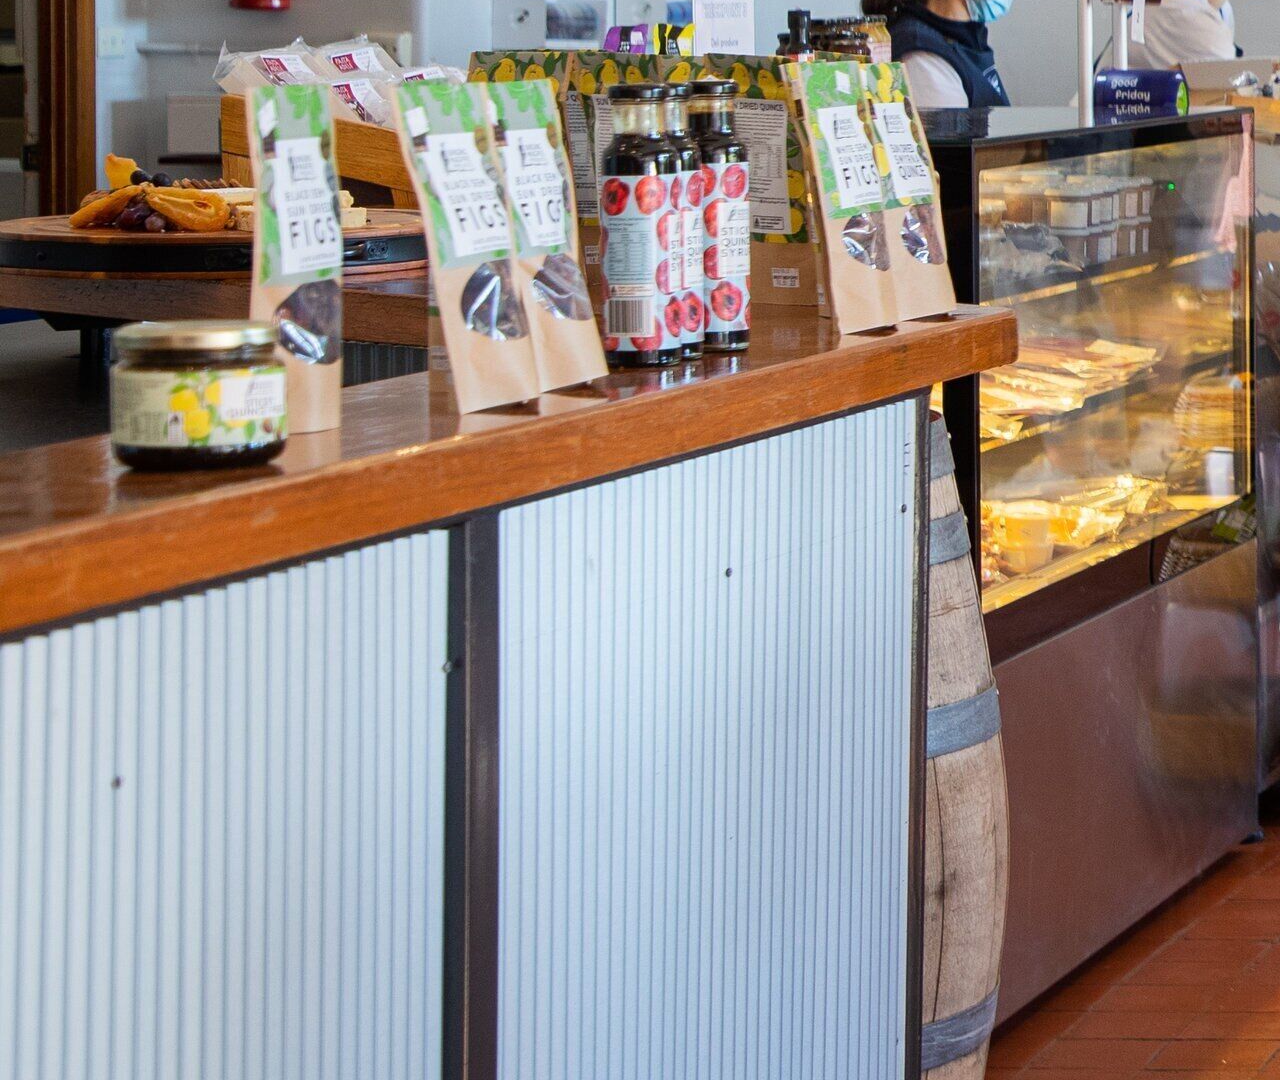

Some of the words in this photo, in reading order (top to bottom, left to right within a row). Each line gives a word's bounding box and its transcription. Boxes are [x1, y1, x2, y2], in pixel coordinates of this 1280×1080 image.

[1110, 76, 1139, 90] good
[739, 103, 759, 111] DRIED
[760, 103, 784, 112] QUINCE
[842, 163, 879, 190] FIGS
[454, 202, 507, 234] FIGS
[288, 215, 338, 251] FIGS
